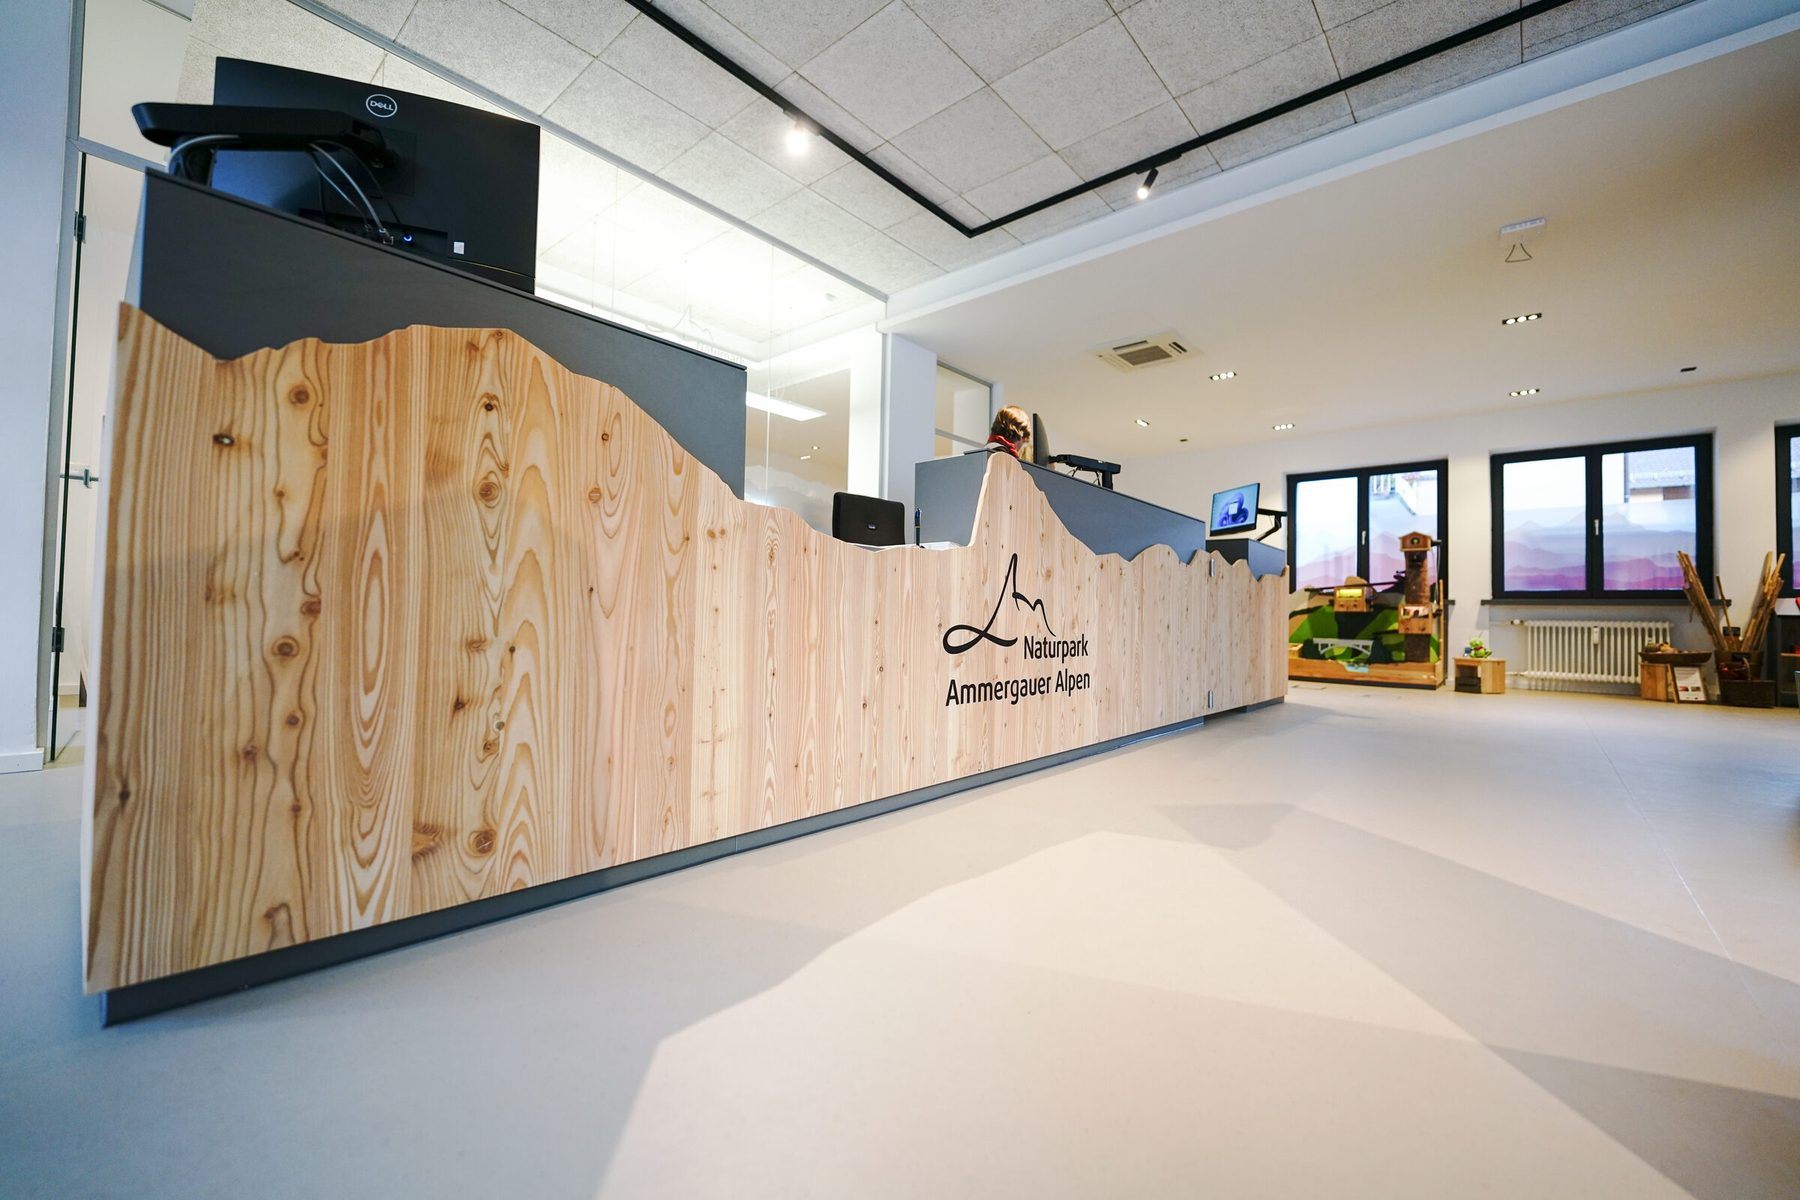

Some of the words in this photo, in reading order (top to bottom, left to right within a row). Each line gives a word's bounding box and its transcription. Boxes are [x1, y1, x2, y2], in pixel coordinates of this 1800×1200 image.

[370, 100, 394, 111] DELL
[1024, 634, 1088, 664] Naturpark
[945, 676, 1051, 706] Ammergauer
[1055, 668, 1090, 697] Alpen
